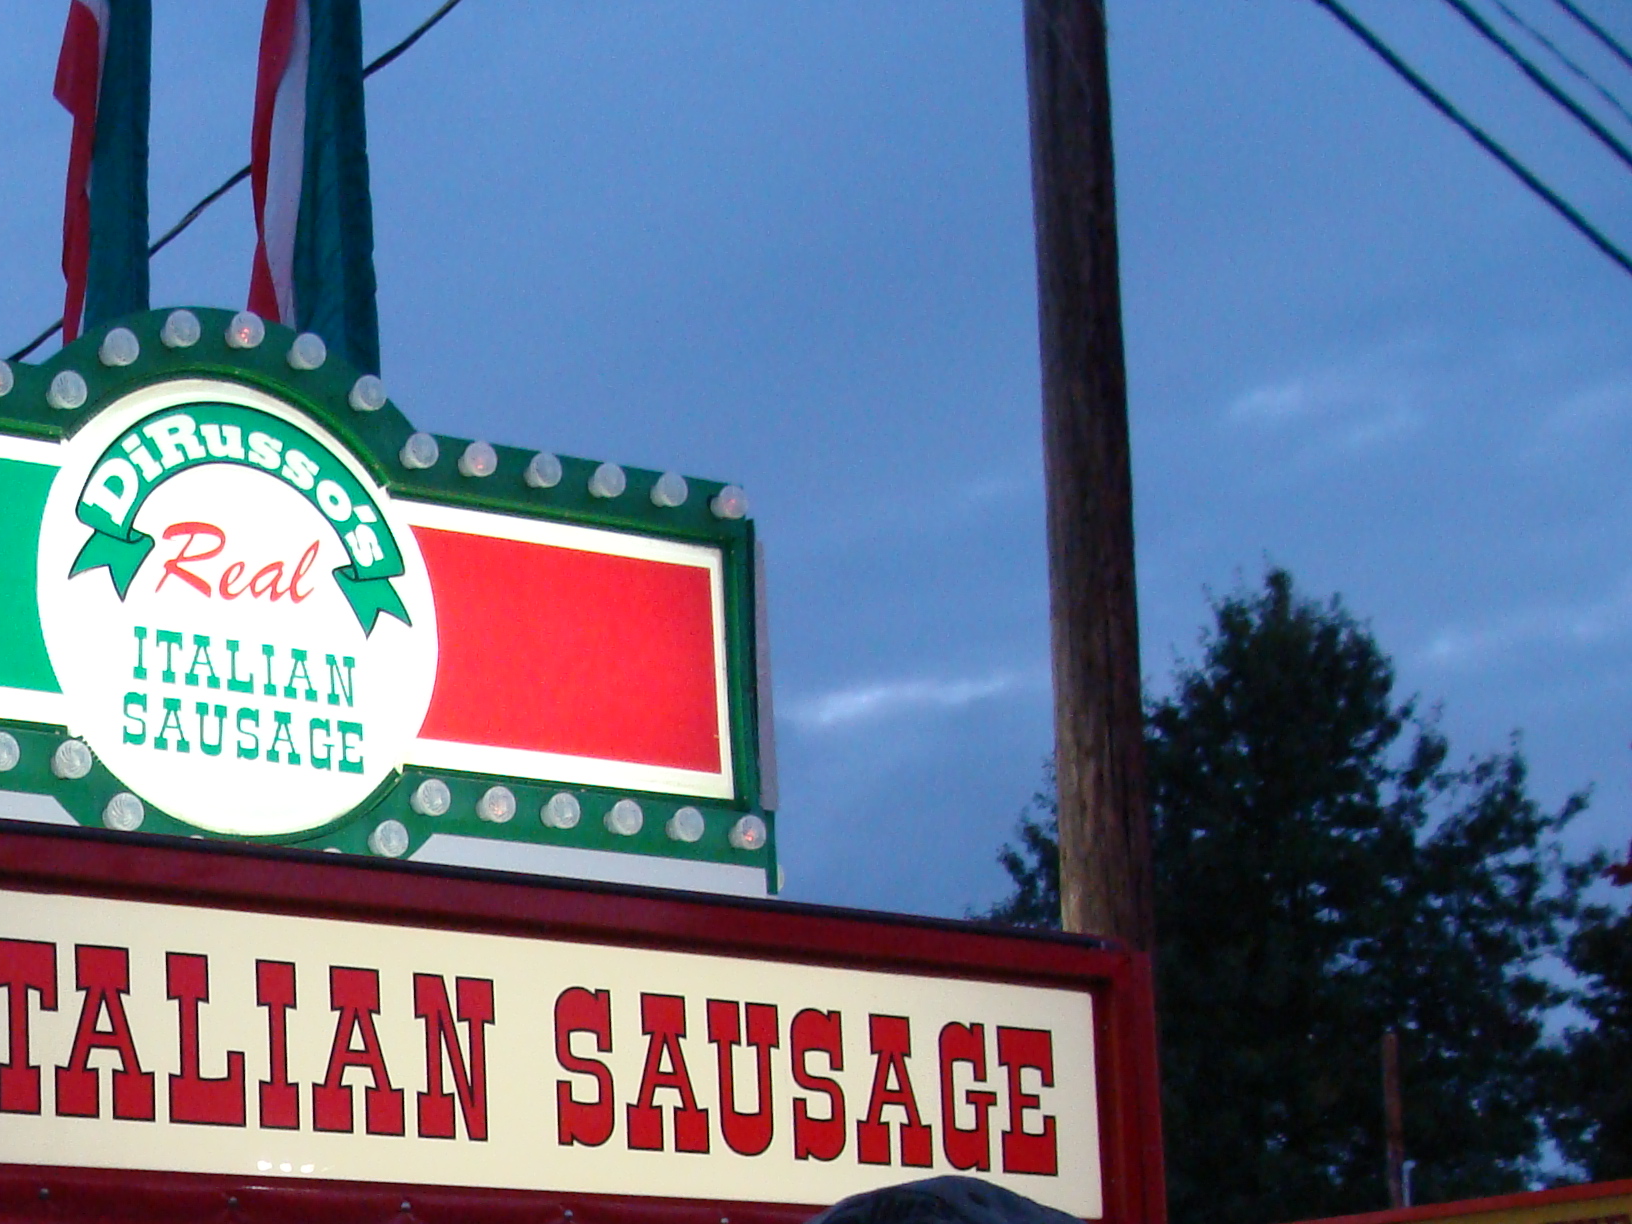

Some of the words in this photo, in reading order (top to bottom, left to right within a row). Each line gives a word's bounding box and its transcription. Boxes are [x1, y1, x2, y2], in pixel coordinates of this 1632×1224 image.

[82, 413, 384, 567] DiRusso's
[155, 521, 320, 604] Real
[133, 626, 356, 708] ITALIAN
[122, 692, 365, 775] SAUSAGE
[553, 984, 1060, 1178] SAUSAGE
